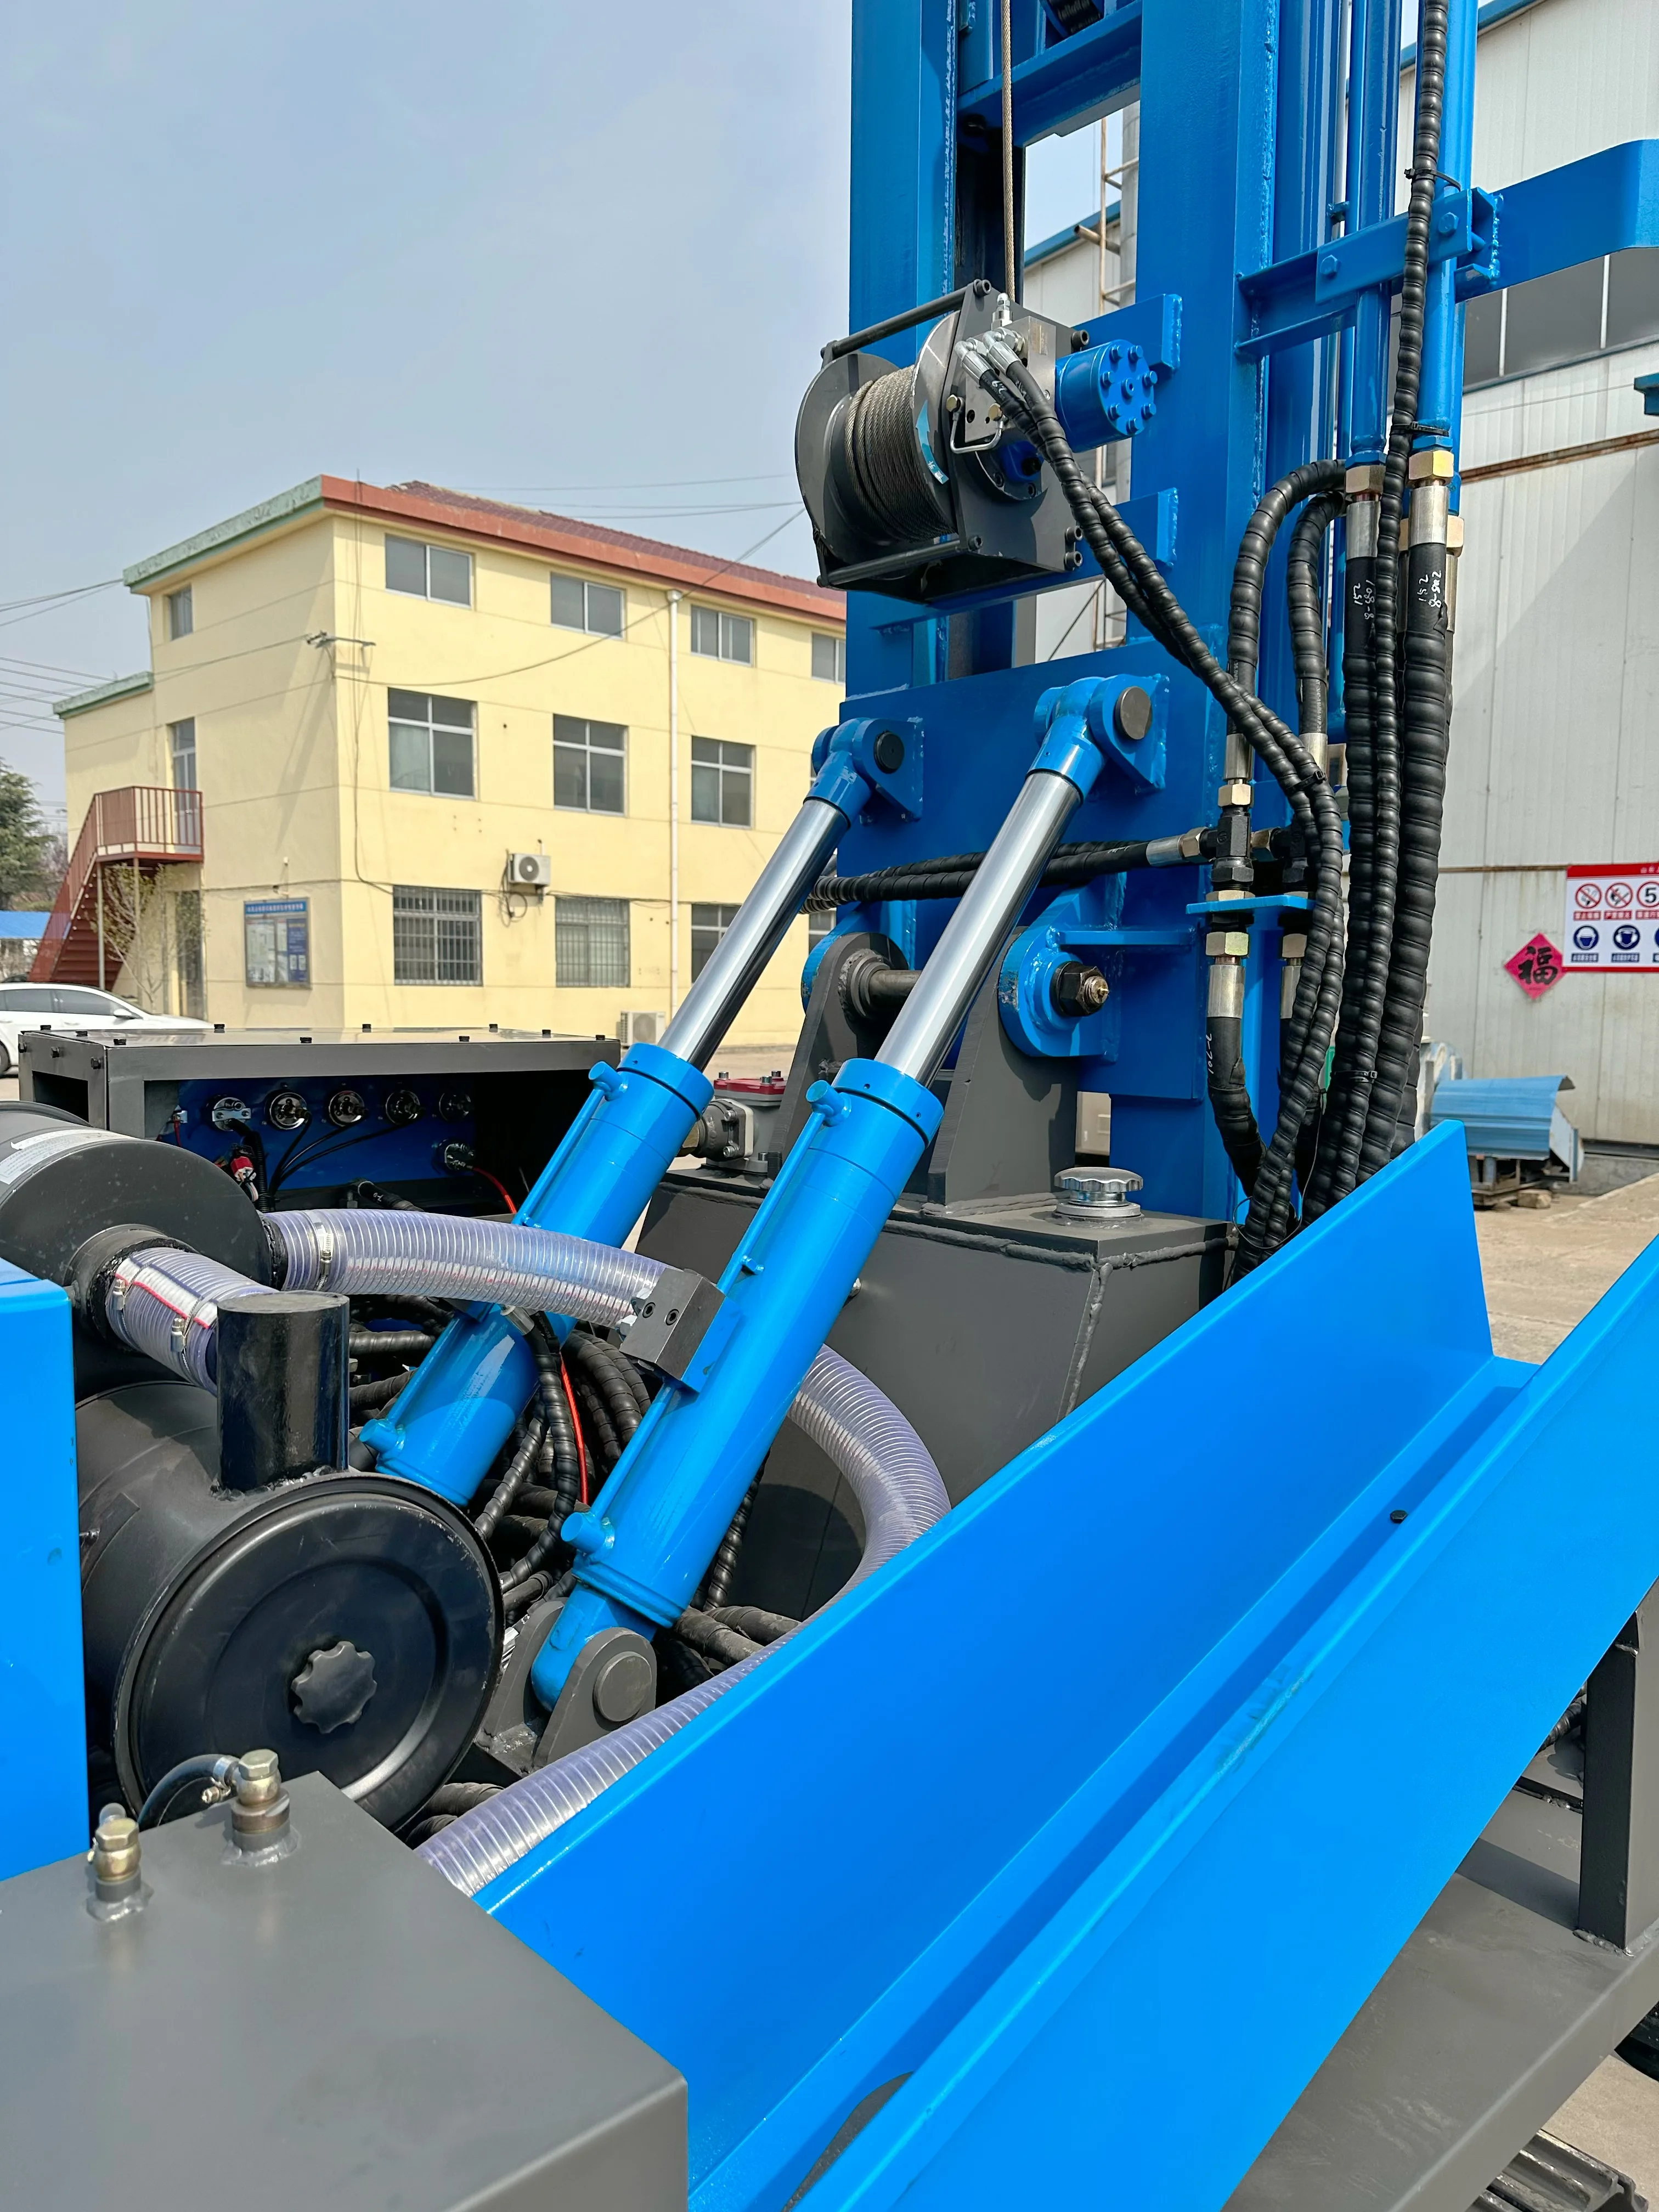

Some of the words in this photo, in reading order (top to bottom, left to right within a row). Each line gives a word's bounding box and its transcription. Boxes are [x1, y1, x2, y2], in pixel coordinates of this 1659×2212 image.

[1353, 583, 1363, 605] 152
[1417, 574, 1429, 602] 152
[1645, 887, 1657, 903] 5
[1517, 946, 1559, 985] 福
